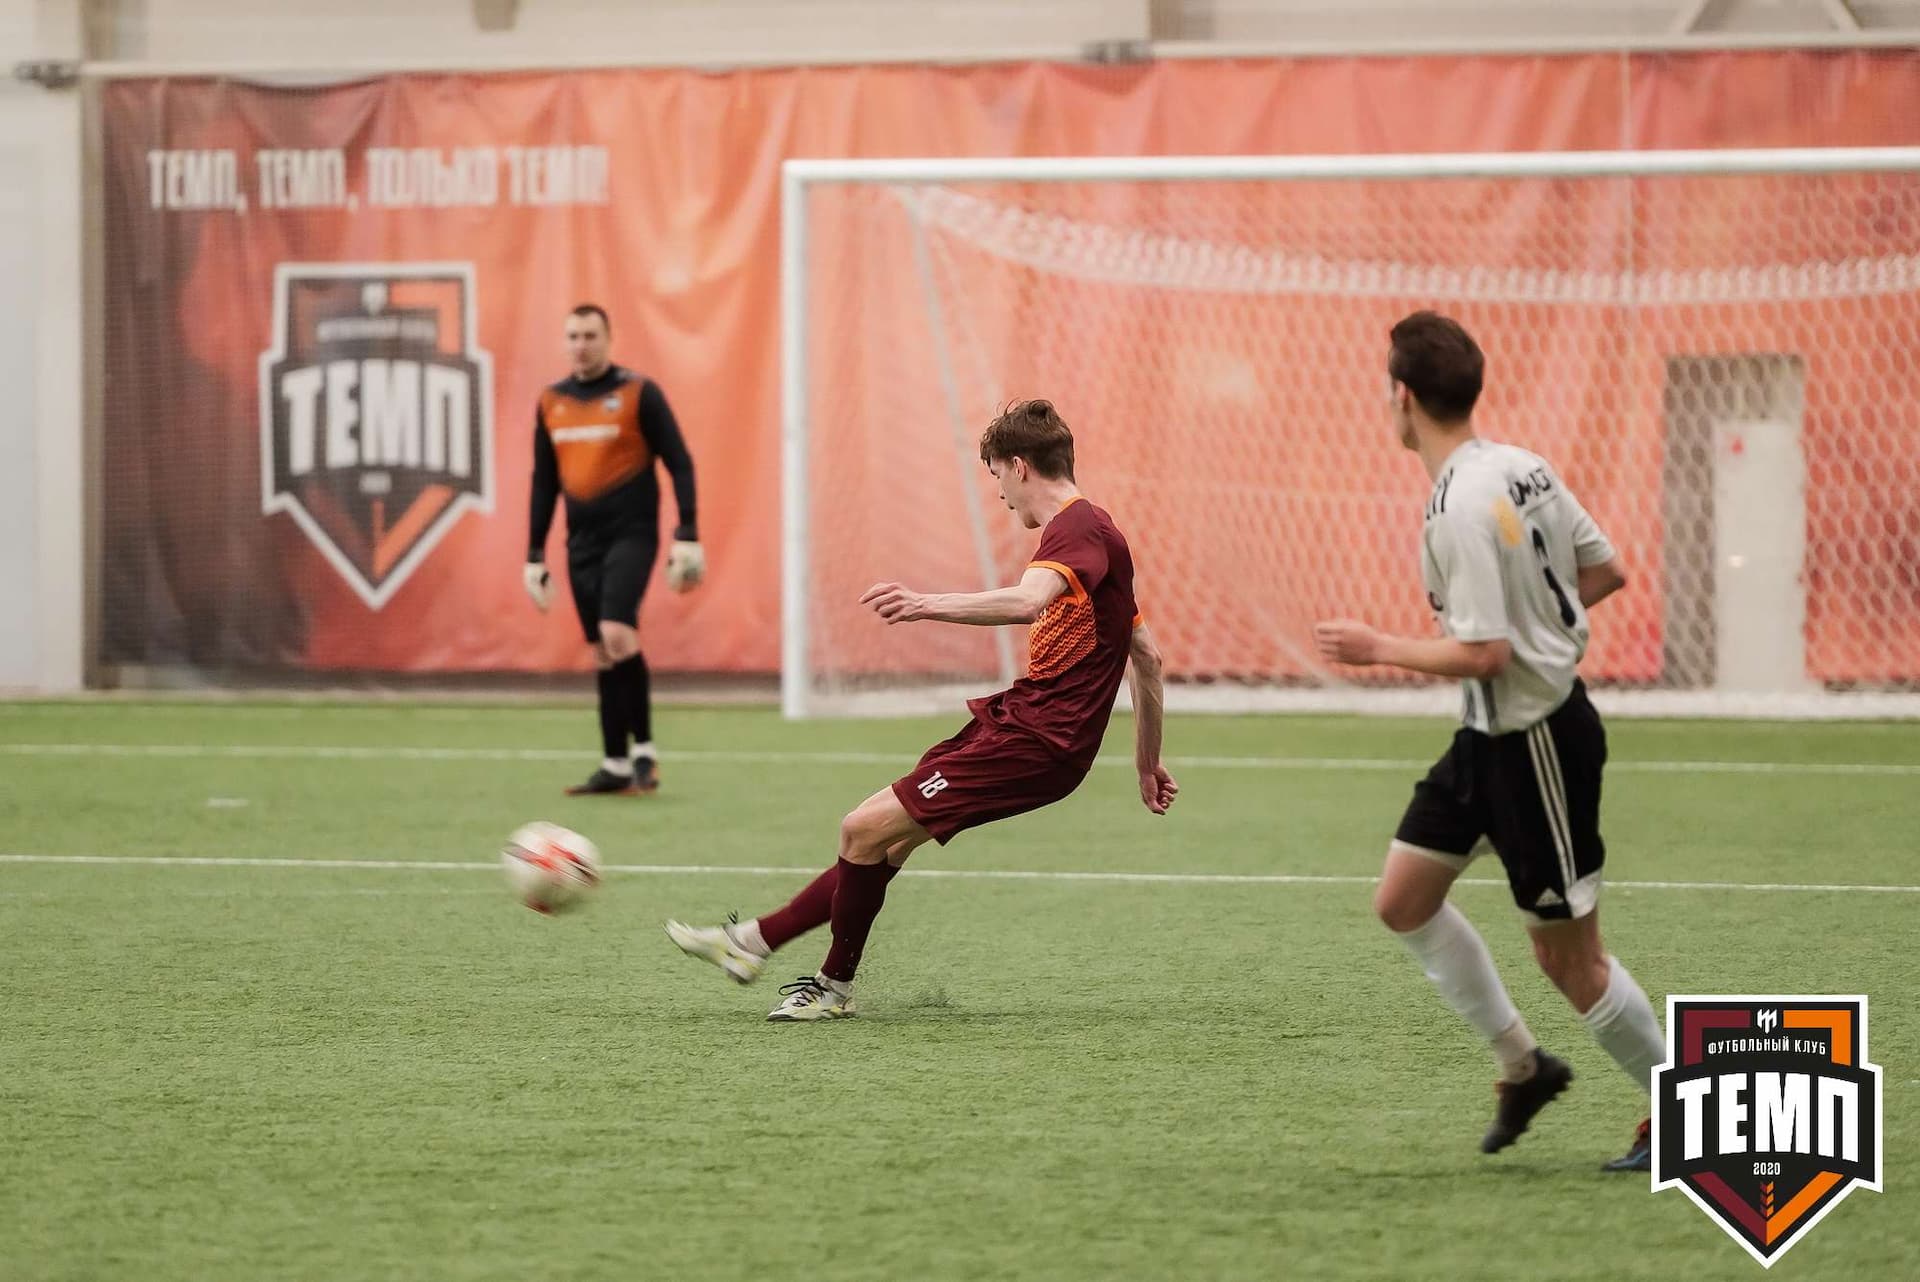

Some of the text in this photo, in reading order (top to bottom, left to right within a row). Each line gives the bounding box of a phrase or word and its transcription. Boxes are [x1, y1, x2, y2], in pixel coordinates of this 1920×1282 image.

[147, 149, 248, 215] ТЕМП,
[256, 148, 358, 213] ТЕМП,
[281, 358, 472, 478] ТЕМП
[917, 770, 949, 799] 18
